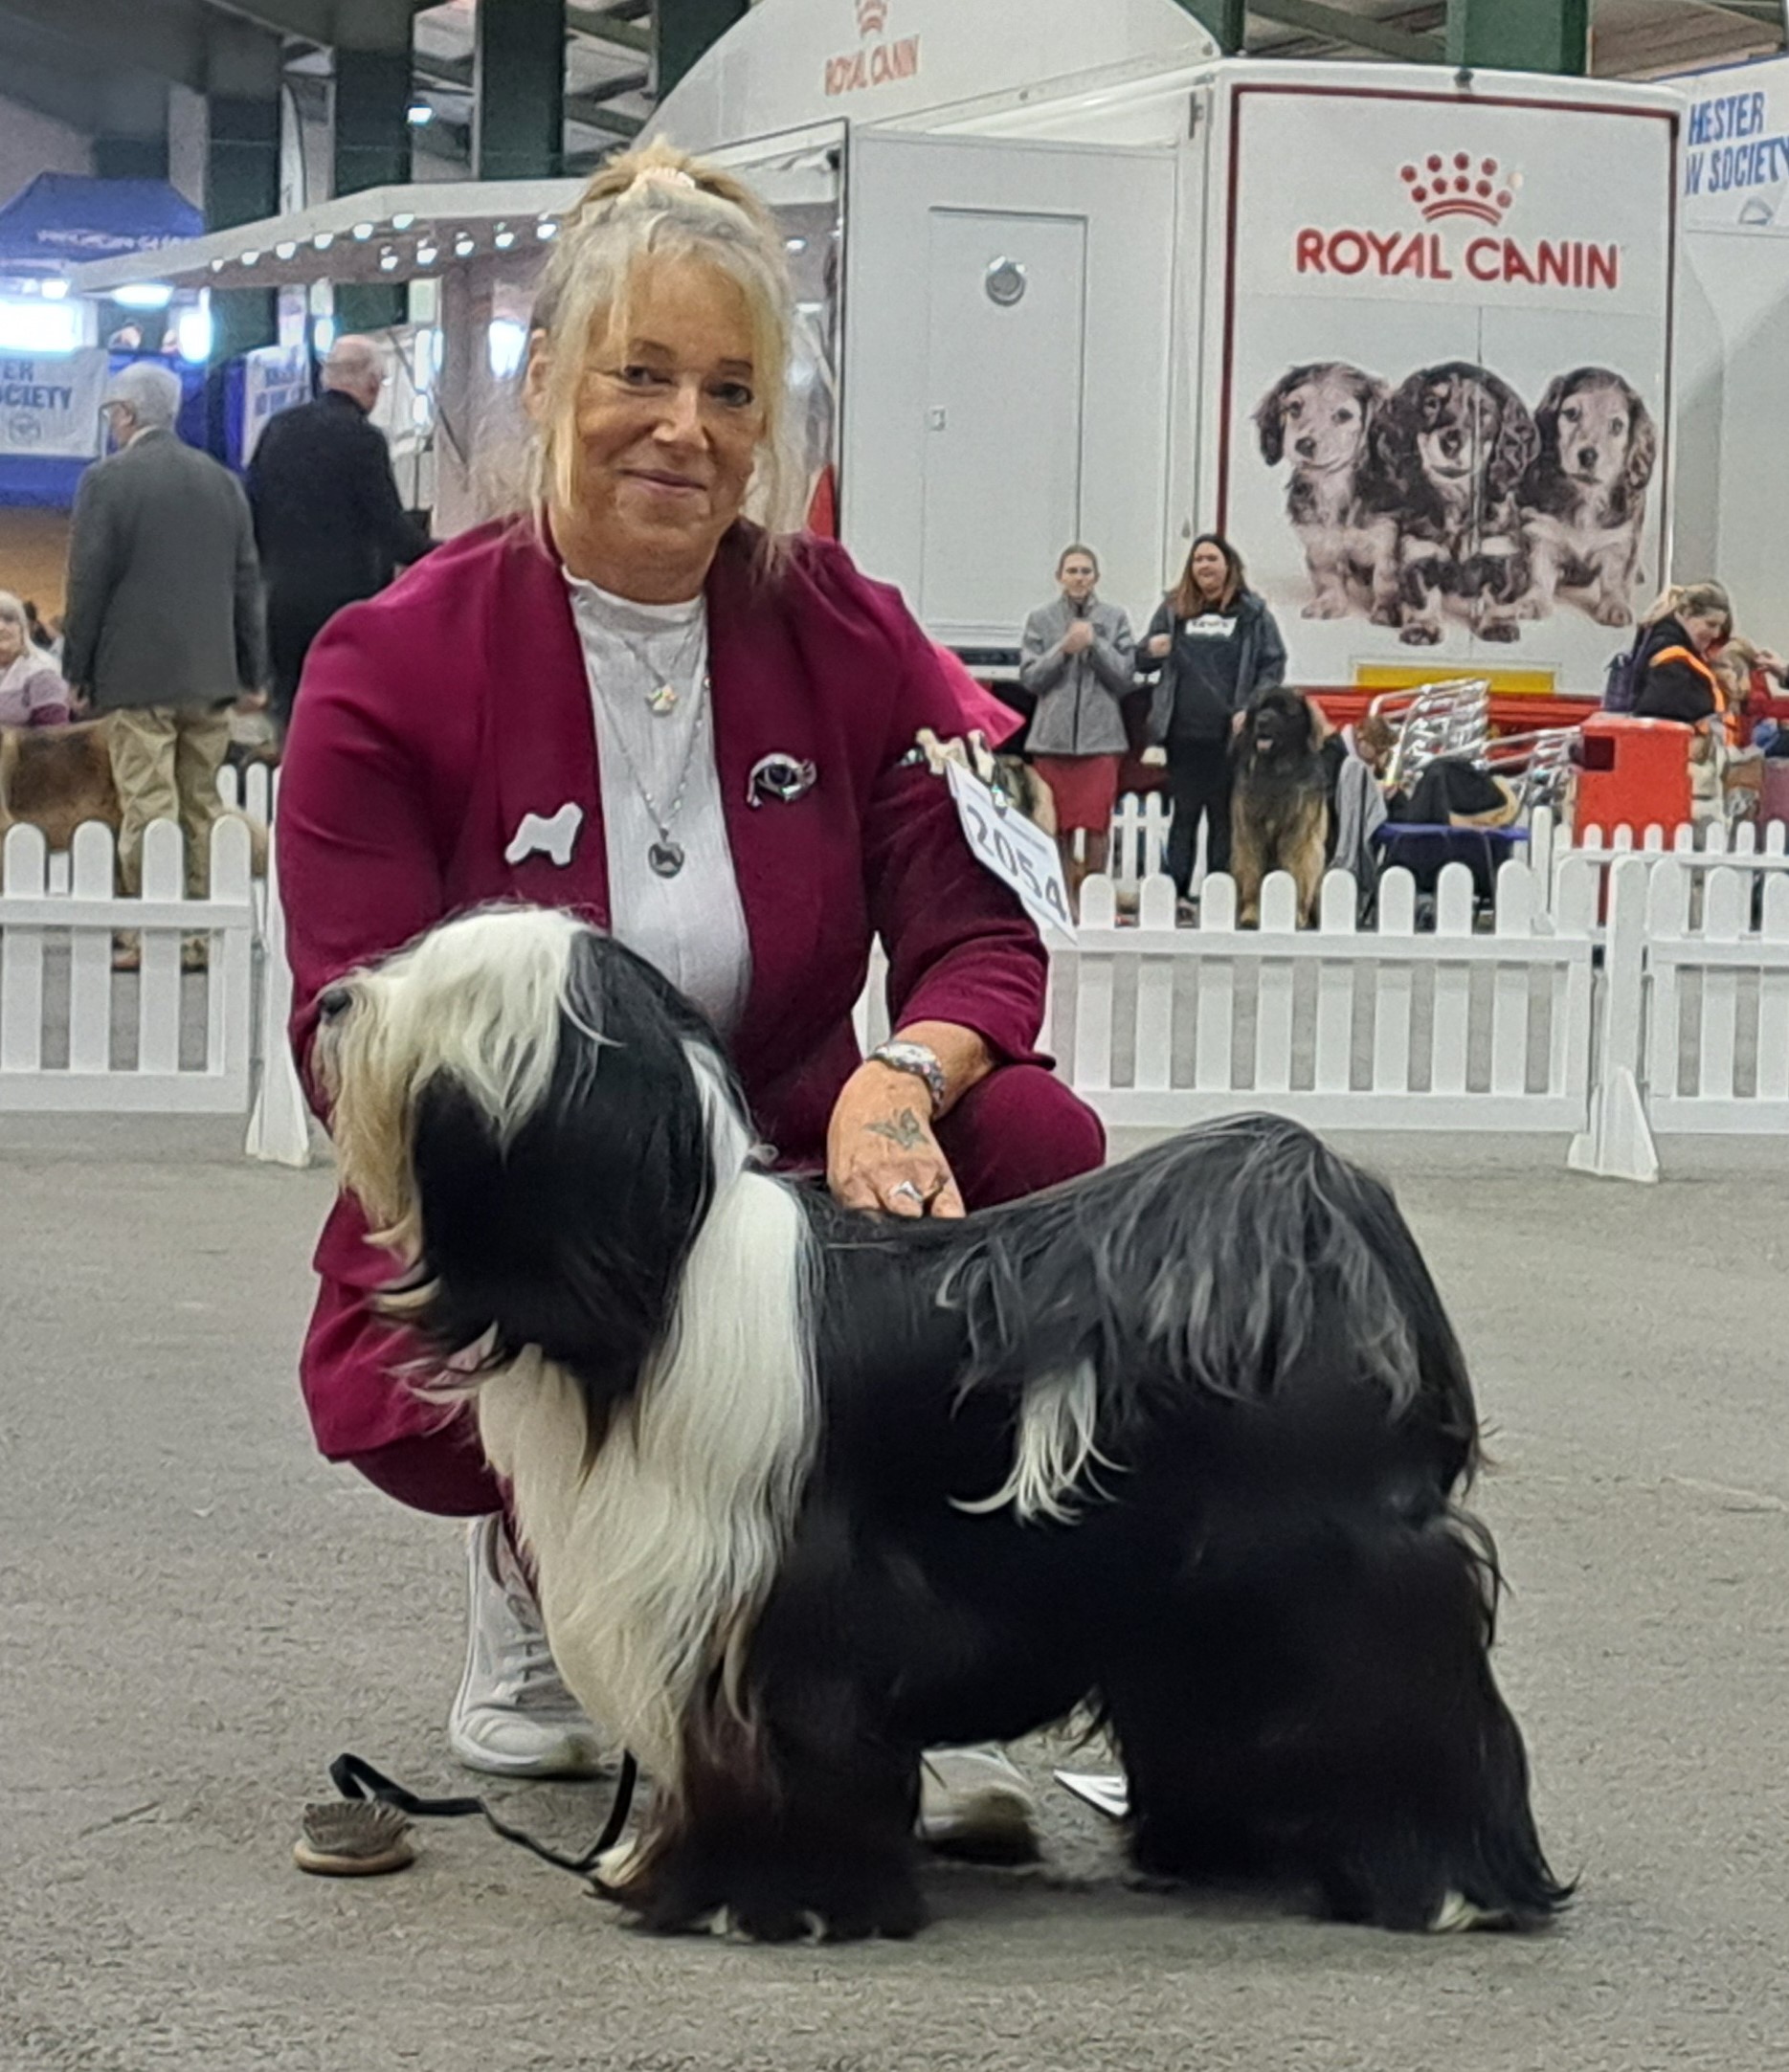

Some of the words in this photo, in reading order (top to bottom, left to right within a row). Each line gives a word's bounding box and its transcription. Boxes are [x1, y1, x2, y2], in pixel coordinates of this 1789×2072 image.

[1687, 91, 1765, 146] HESTER
[1296, 228, 1452, 279] ROYAL
[1465, 236, 1618, 290] CANIN
[0, 383, 73, 410] CIETY
[966, 803, 1067, 923] 2054
